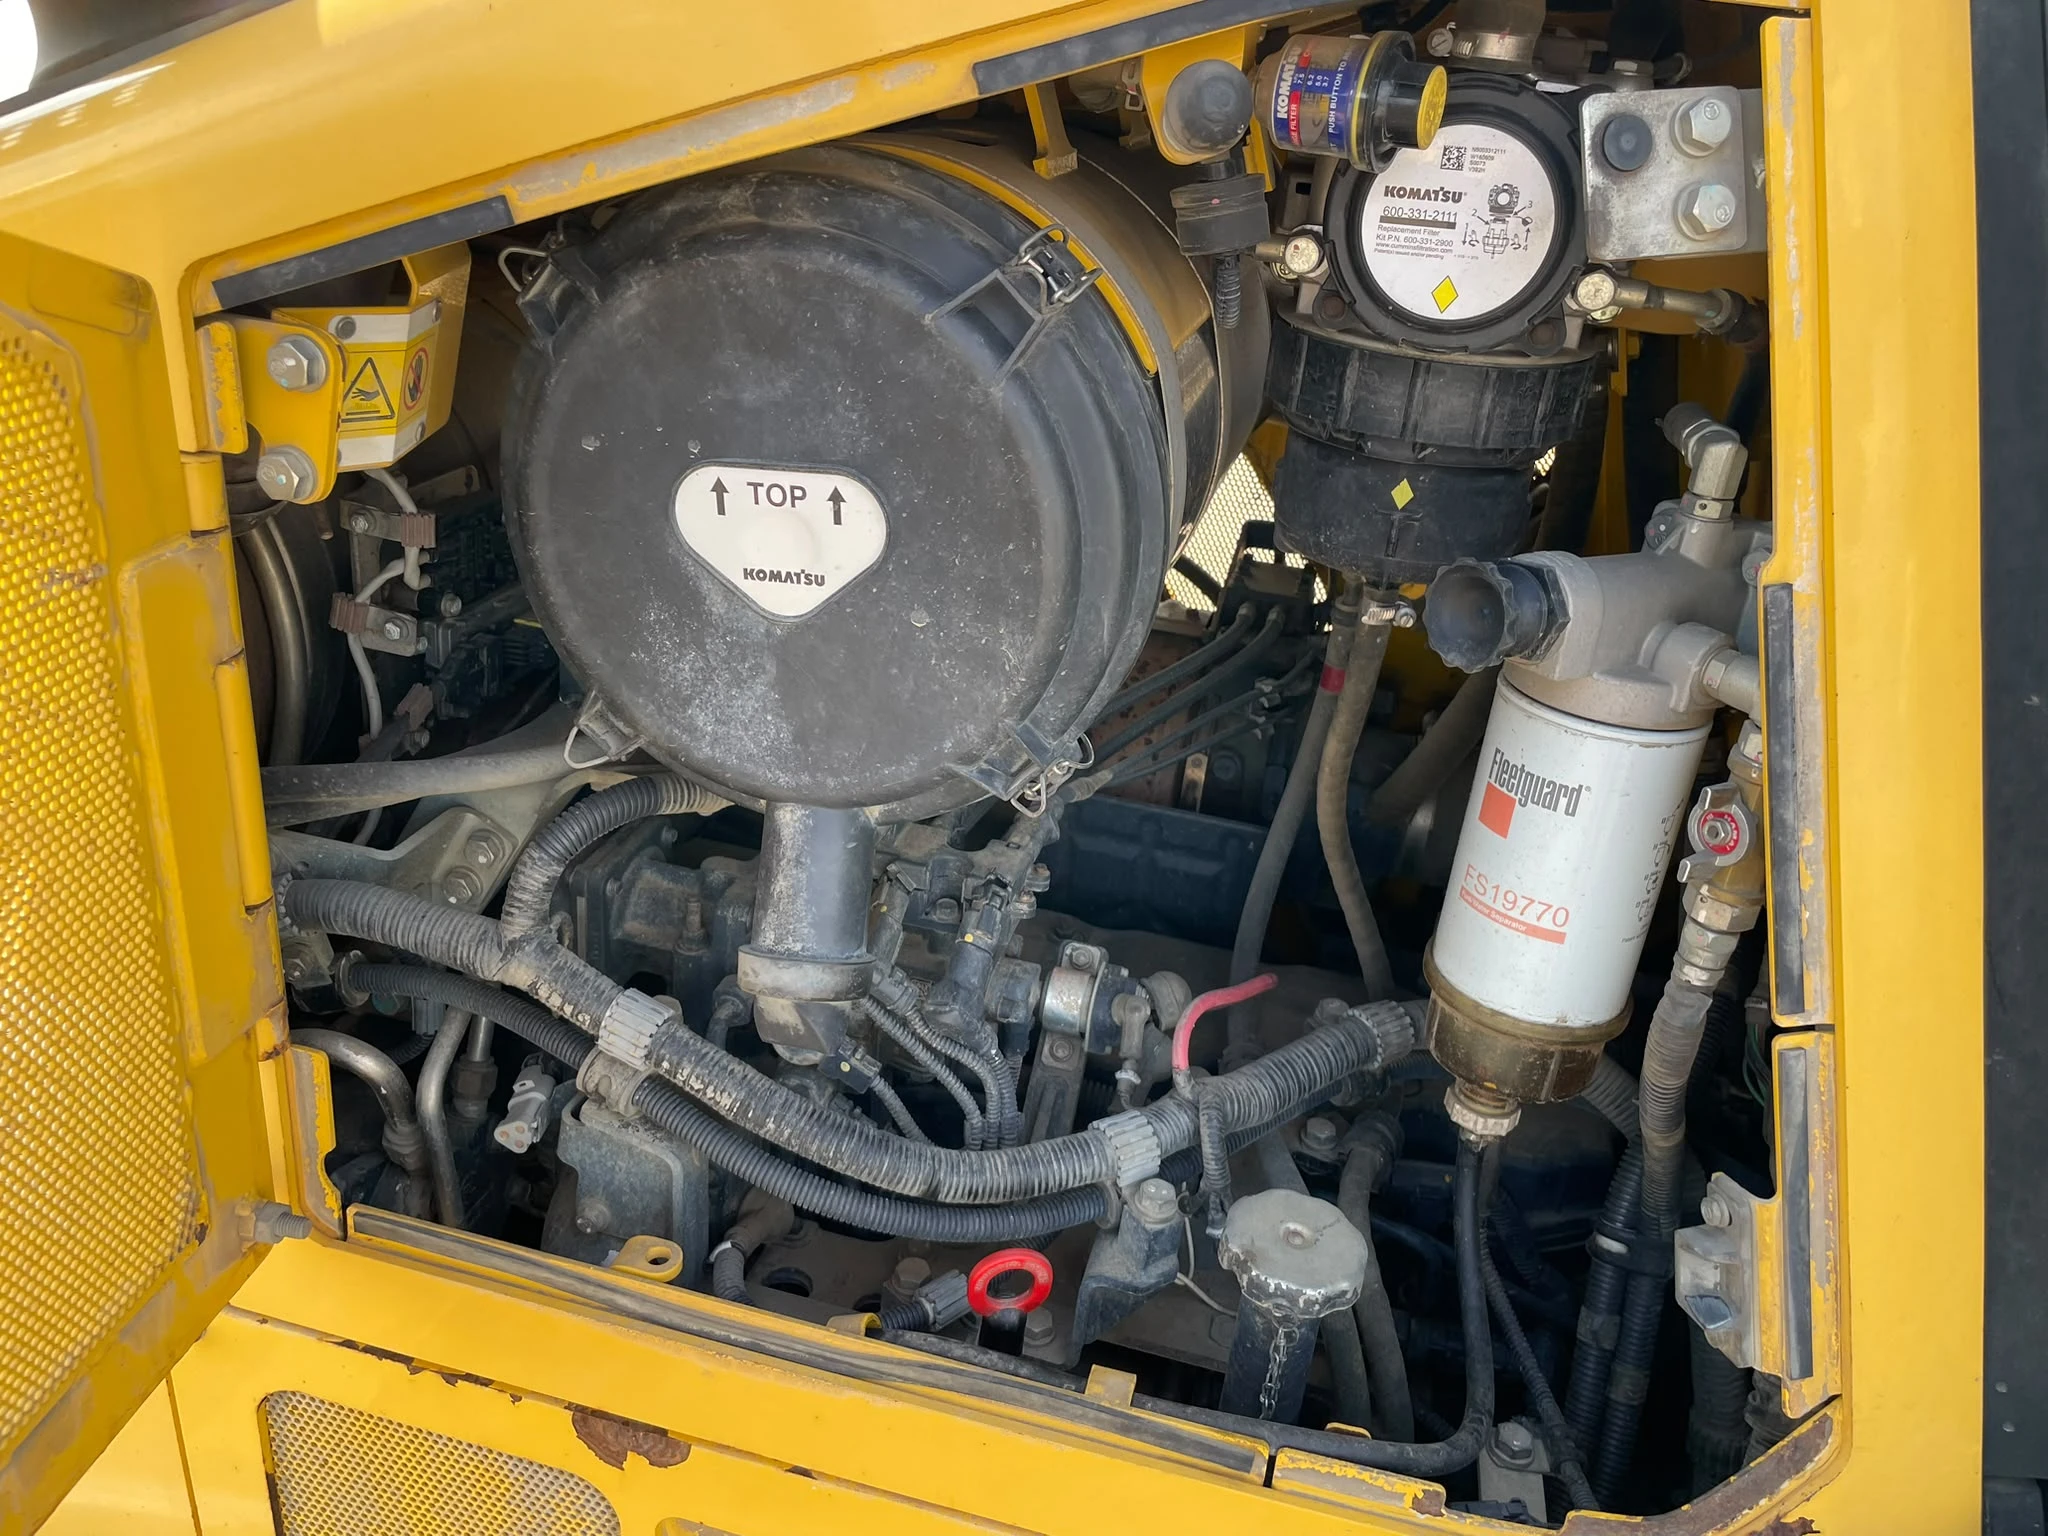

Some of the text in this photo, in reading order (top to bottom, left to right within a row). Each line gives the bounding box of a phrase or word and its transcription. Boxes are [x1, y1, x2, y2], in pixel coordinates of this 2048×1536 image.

[1338, 60, 1348, 72] TO
[1307, 74, 1315, 86] 6.2
[1315, 75, 1323, 87] 5.0
[1330, 73, 1344, 109] BUTTON
[1289, 103, 1298, 130] FILTER
[1328, 110, 1337, 133] PUSH
[1383, 186, 1464, 204] KOMATSU
[1382, 205, 1458, 222] 600-331-2111
[1377, 224, 1441, 236] Replacement Filter
[1375, 234, 1386, 242] Kit
[1403, 236, 1454, 247] 600-331-2900
[746, 481, 807, 508] TOP
[743, 567, 826, 587] KOMATSU
[1488, 747, 1584, 817] Fleetguard
[1464, 863, 1570, 928] FS19770
[1490, 909, 1528, 932] Separator
